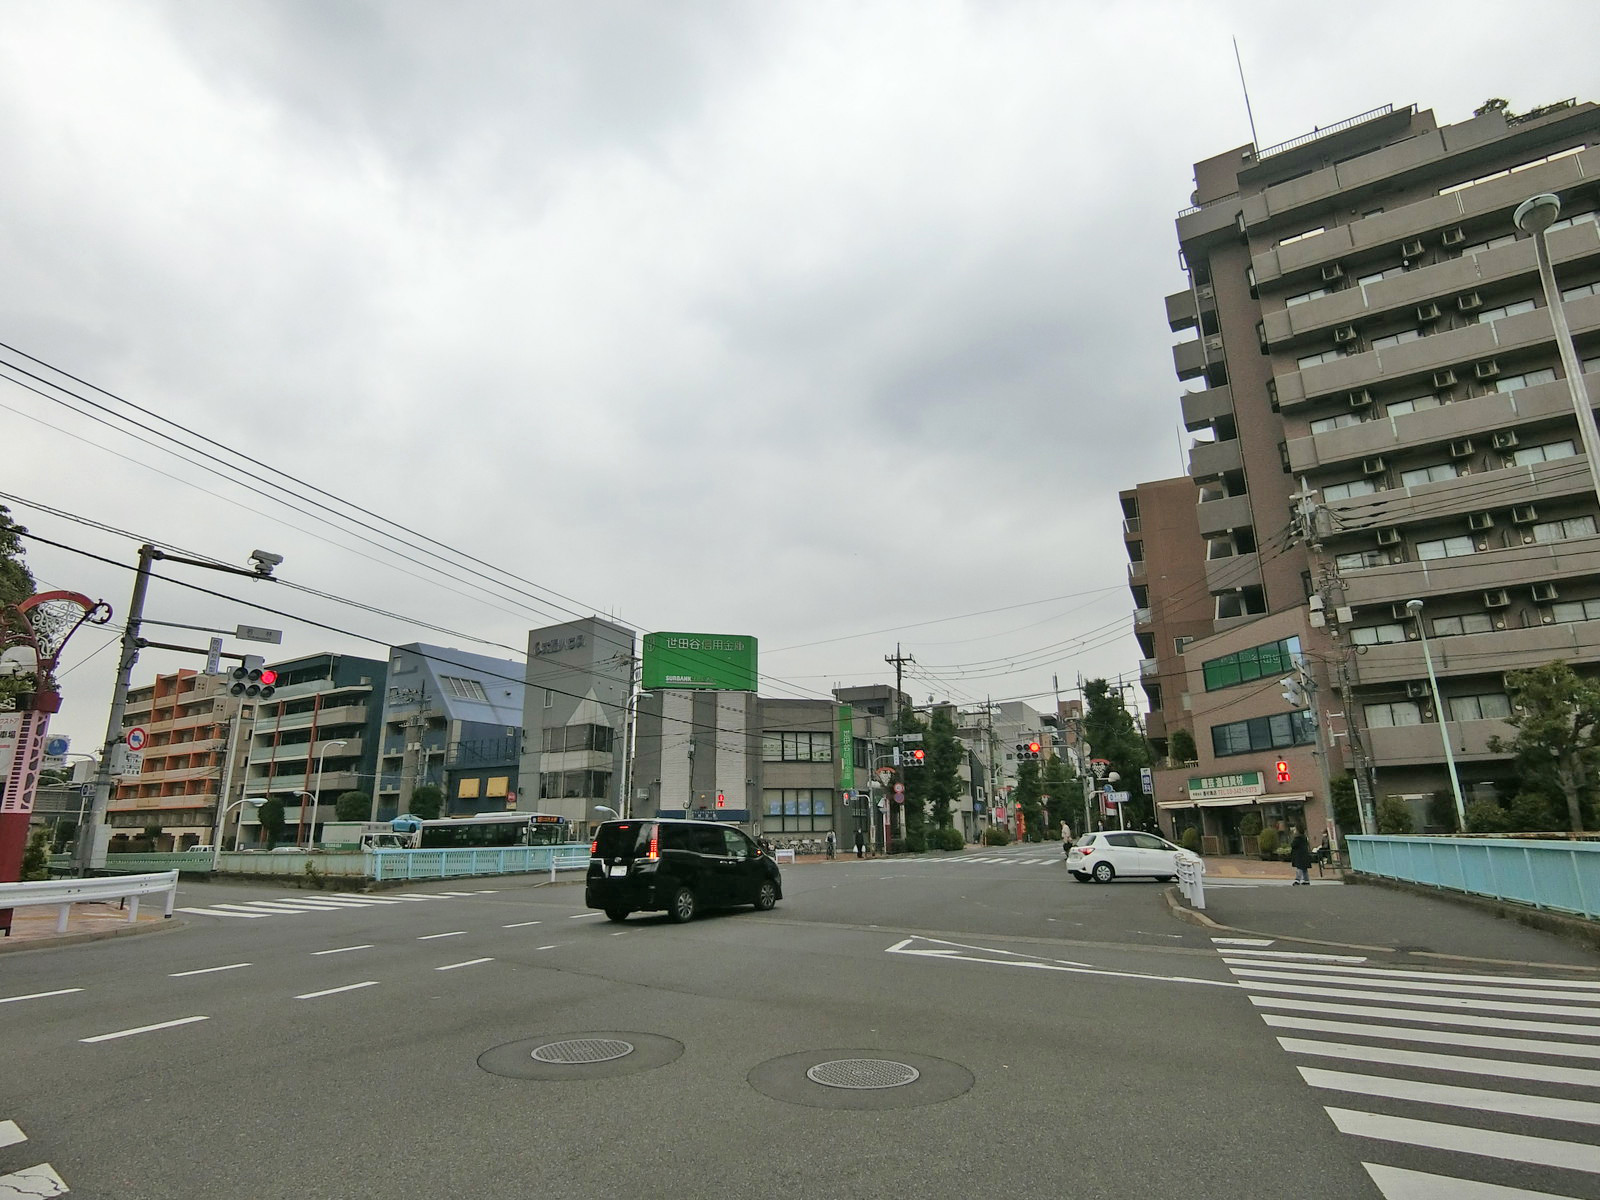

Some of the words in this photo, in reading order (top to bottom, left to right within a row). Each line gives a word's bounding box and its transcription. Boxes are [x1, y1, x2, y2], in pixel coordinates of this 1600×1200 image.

[667, 638, 744, 650] 世田谷信用金庫
